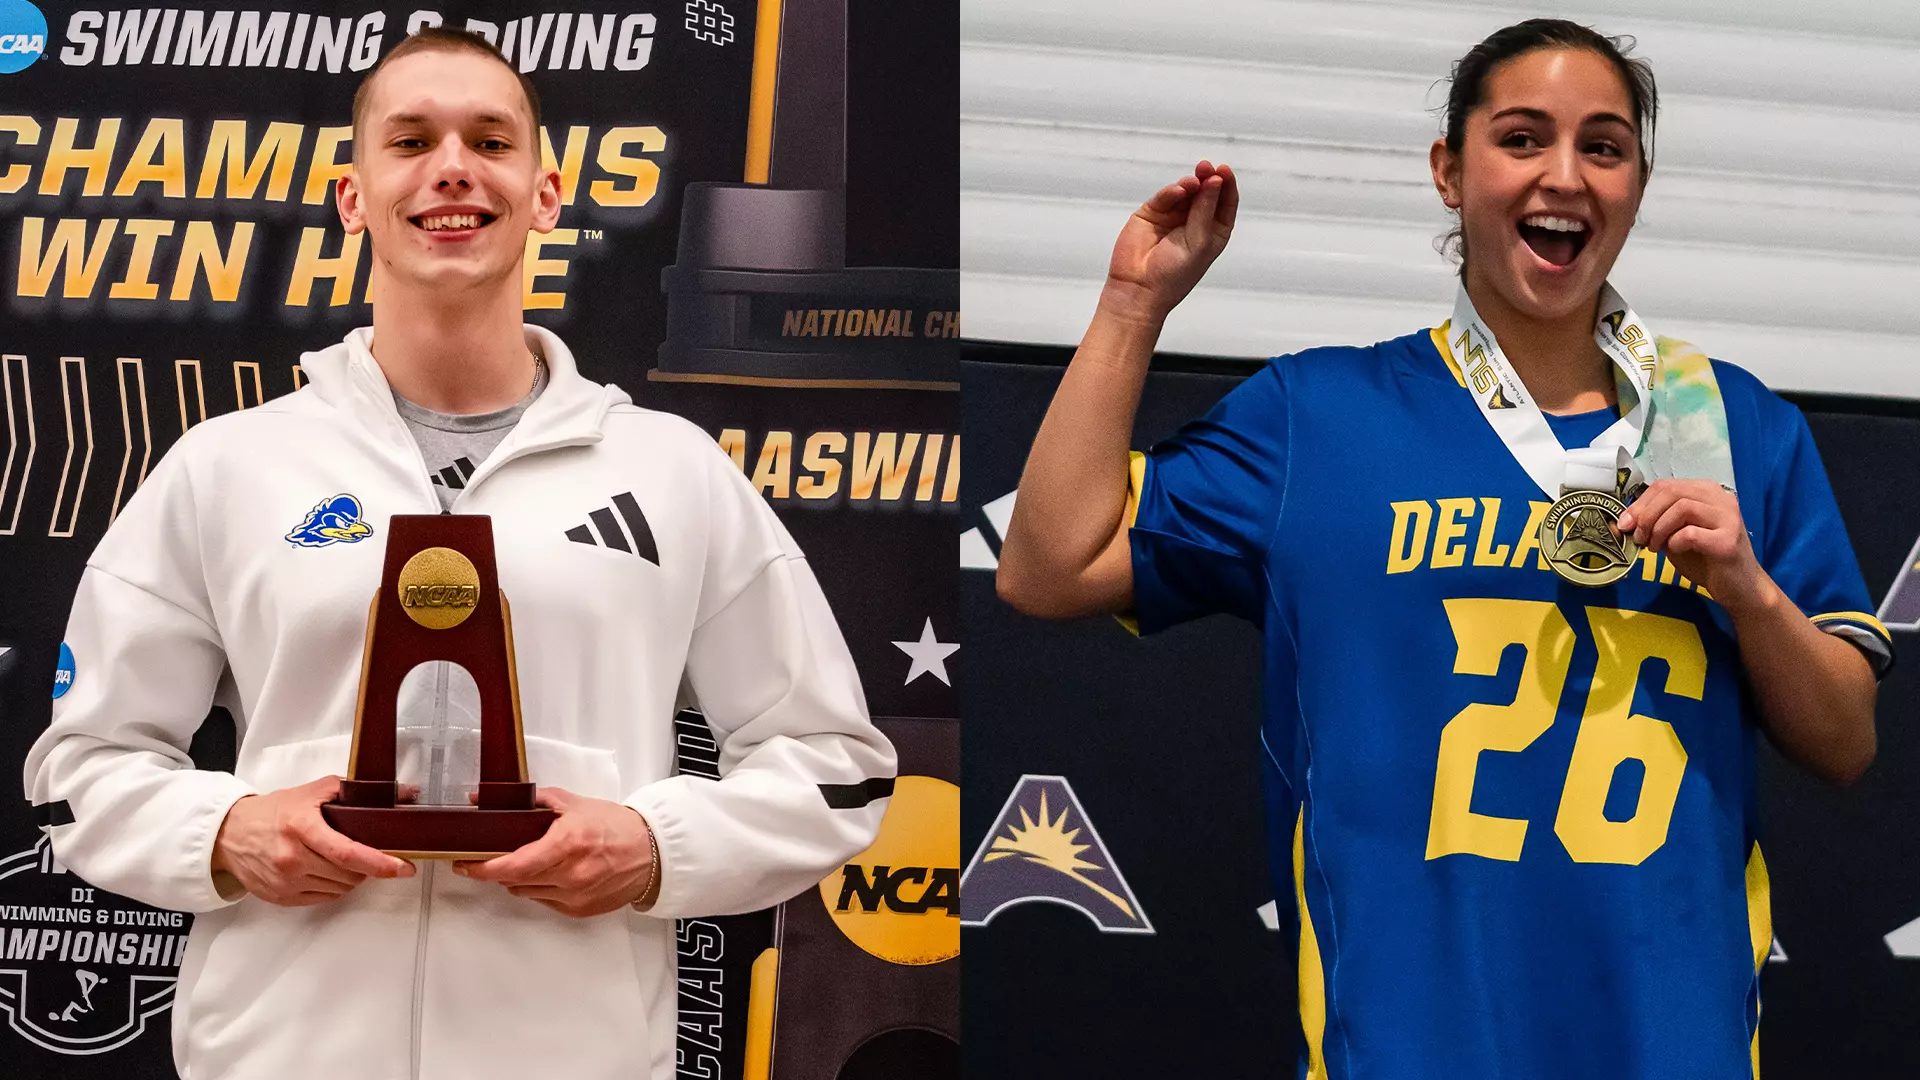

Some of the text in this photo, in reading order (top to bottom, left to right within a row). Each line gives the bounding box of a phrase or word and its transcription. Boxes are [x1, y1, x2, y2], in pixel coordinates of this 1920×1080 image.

[59, 9, 387, 75] SWIMMING
[0, 115, 668, 209] CHAMPNS
[15, 216, 579, 310] WIN HE
[782, 308, 914, 338] NATIONAL
[716, 428, 960, 502] AASWI
[1546, 495, 1588, 529] SWIMMING
[1589, 495, 1612, 508] AND
[405, 585, 475, 607] NCAA
[1424, 597, 1708, 866] 26
[71, 887, 95, 904] DI
[96, 909, 110, 925] &
[113, 910, 184, 929] DIVING
